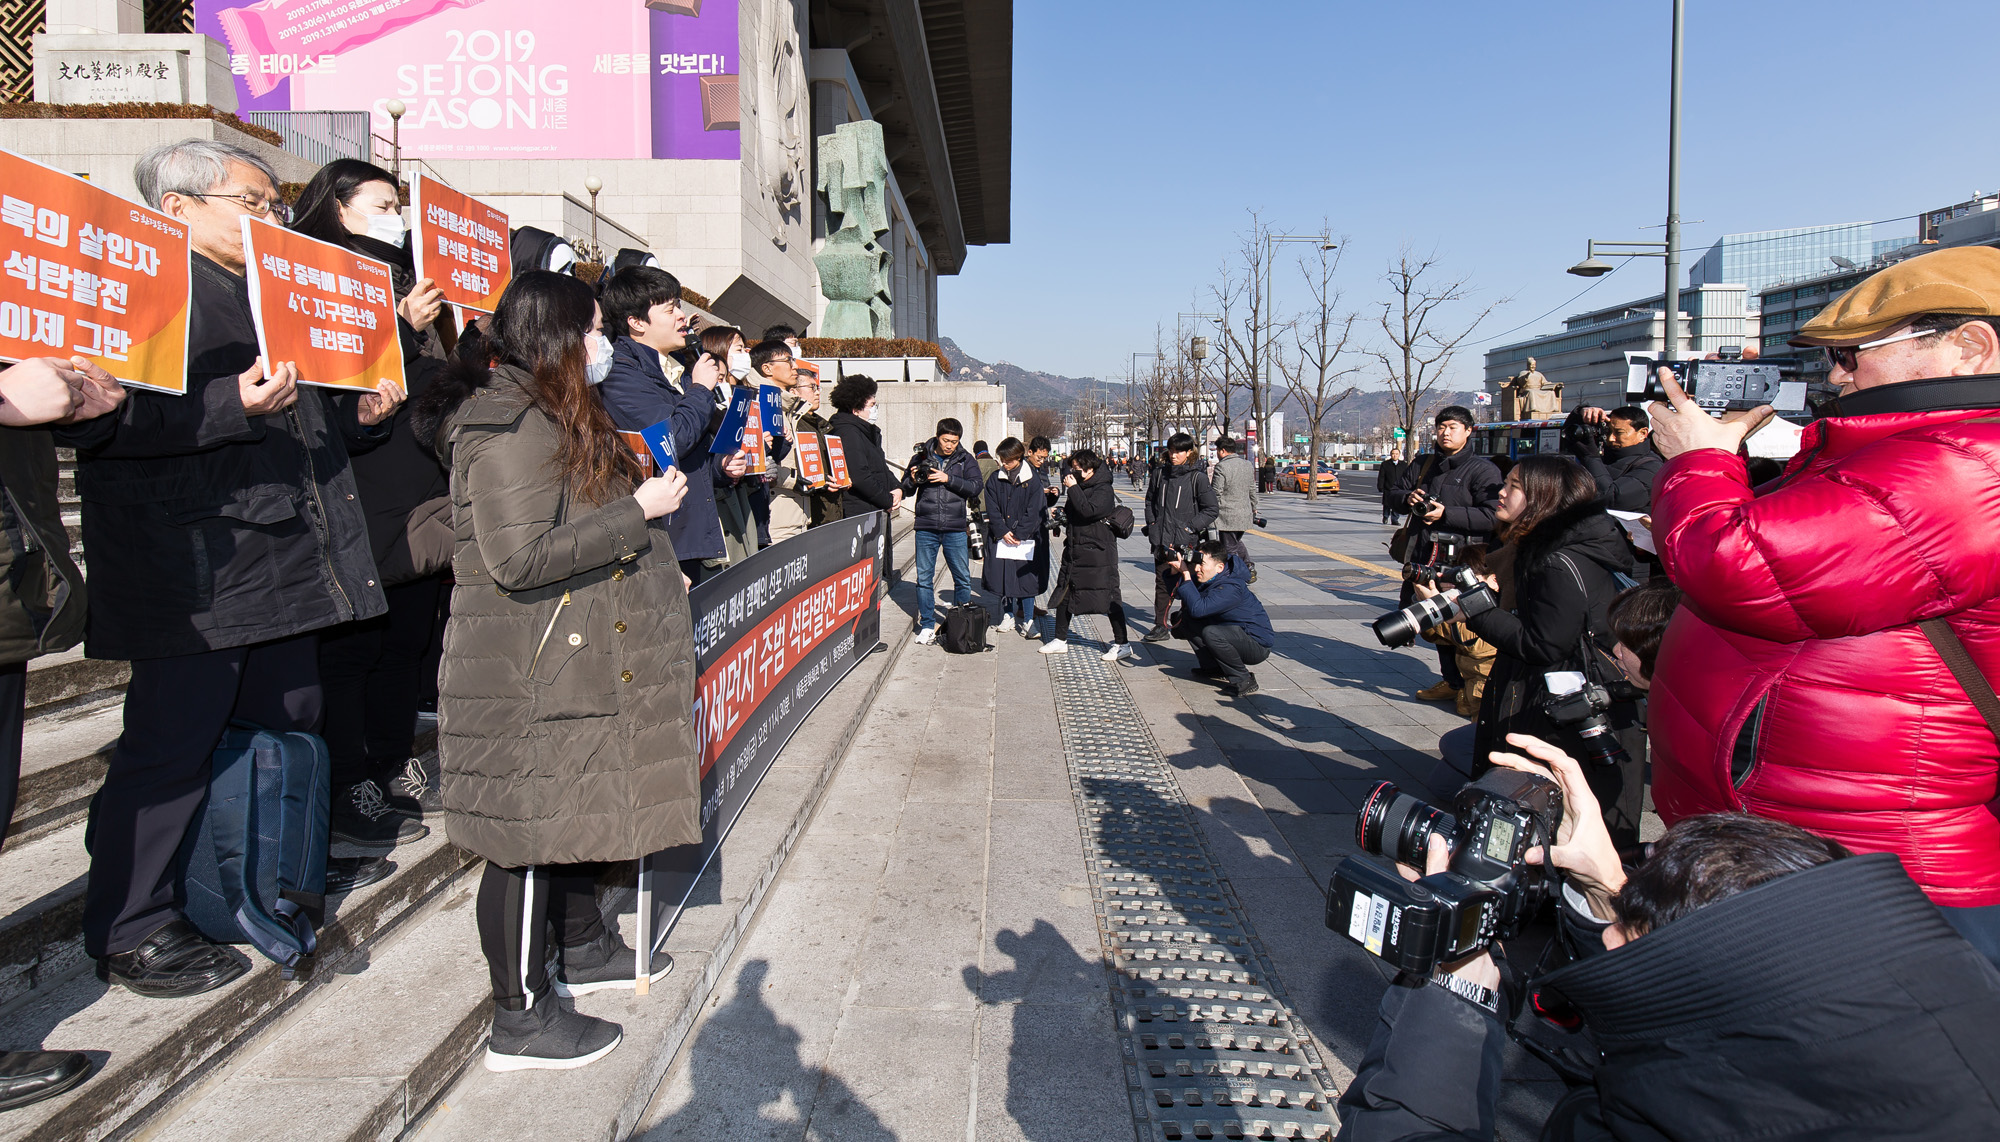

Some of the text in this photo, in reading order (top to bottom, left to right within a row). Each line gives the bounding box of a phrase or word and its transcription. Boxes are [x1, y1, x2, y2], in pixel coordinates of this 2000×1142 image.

[278, 12, 327, 40] 2019.1.30(수)
[325, 4, 349, 20] 14:00
[300, 19, 348, 45] 2019.1.31(목)
[346, 10, 370, 25] 14:00
[369, 4, 386, 16] 개별
[228, 53, 337, 75] 종 테이스트
[446, 29, 535, 62] 2019
[593, 53, 725, 75] 세종을 맛보다!
[397, 64, 569, 96] SEJONG
[542, 97, 568, 113] 세종
[542, 114, 568, 130] 시즌
[426, 203, 504, 250] 산업통상자원부는
[78, 221, 161, 277] 살인자
[437, 234, 498, 273] 탈석탄 로드맵
[4, 250, 129, 315] 석탄발전
[262, 252, 388, 307] 석탄 중독에 빠진 한국
[451, 268, 490, 296] 수립하라
[0, 302, 132, 362] 이제 그만
[312, 297, 377, 330] 지구온난화
[309, 326, 365, 355] 불러온다
[694, 553, 808, 660] 석탄발전 폐쇄 캠페인 선포 기자회견
[759, 613, 785, 688] 주범
[789, 580, 836, 655] 석탄발전
[701, 777, 725, 831] 2019년
[726, 762, 736, 793] 1월
[736, 733, 758, 778] 25일(금)
[757, 719, 768, 748] 오전
[768, 705, 780, 733] 11시
[779, 693, 790, 720] 30분
[796, 663, 820, 700] 세종문화회관
